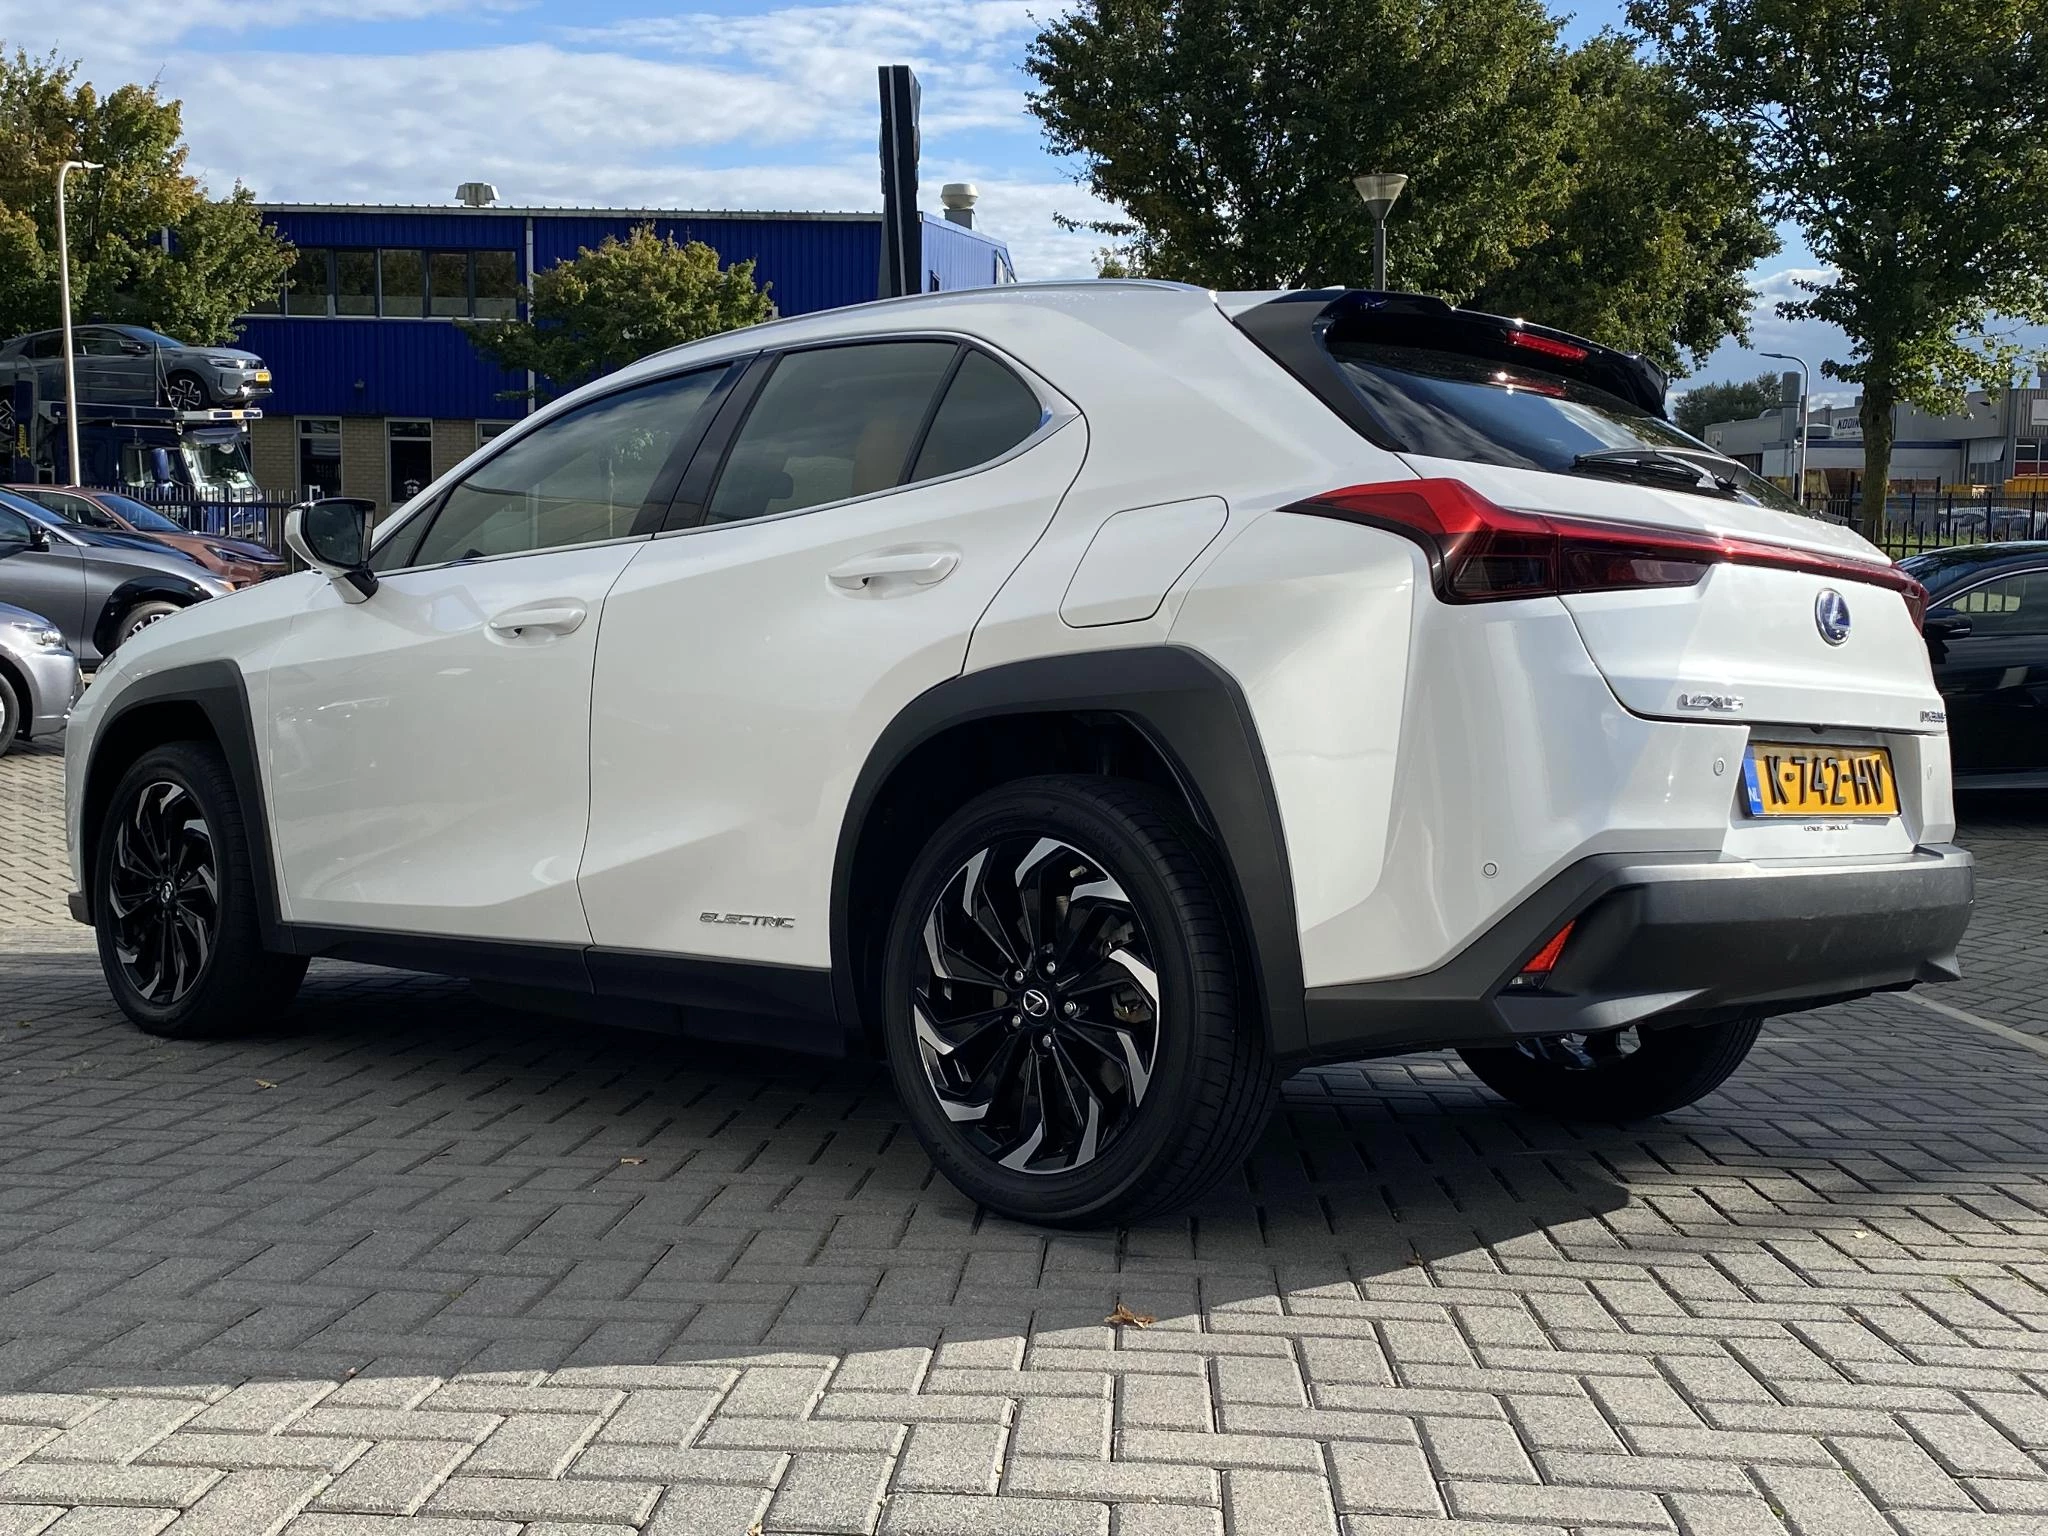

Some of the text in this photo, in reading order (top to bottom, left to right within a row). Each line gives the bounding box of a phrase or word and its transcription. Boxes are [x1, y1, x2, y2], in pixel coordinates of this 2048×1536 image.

[1765, 755, 1884, 805] K-742-HV
[1748, 786, 1761, 802] NL
[699, 912, 796, 929] ELECTRIC
